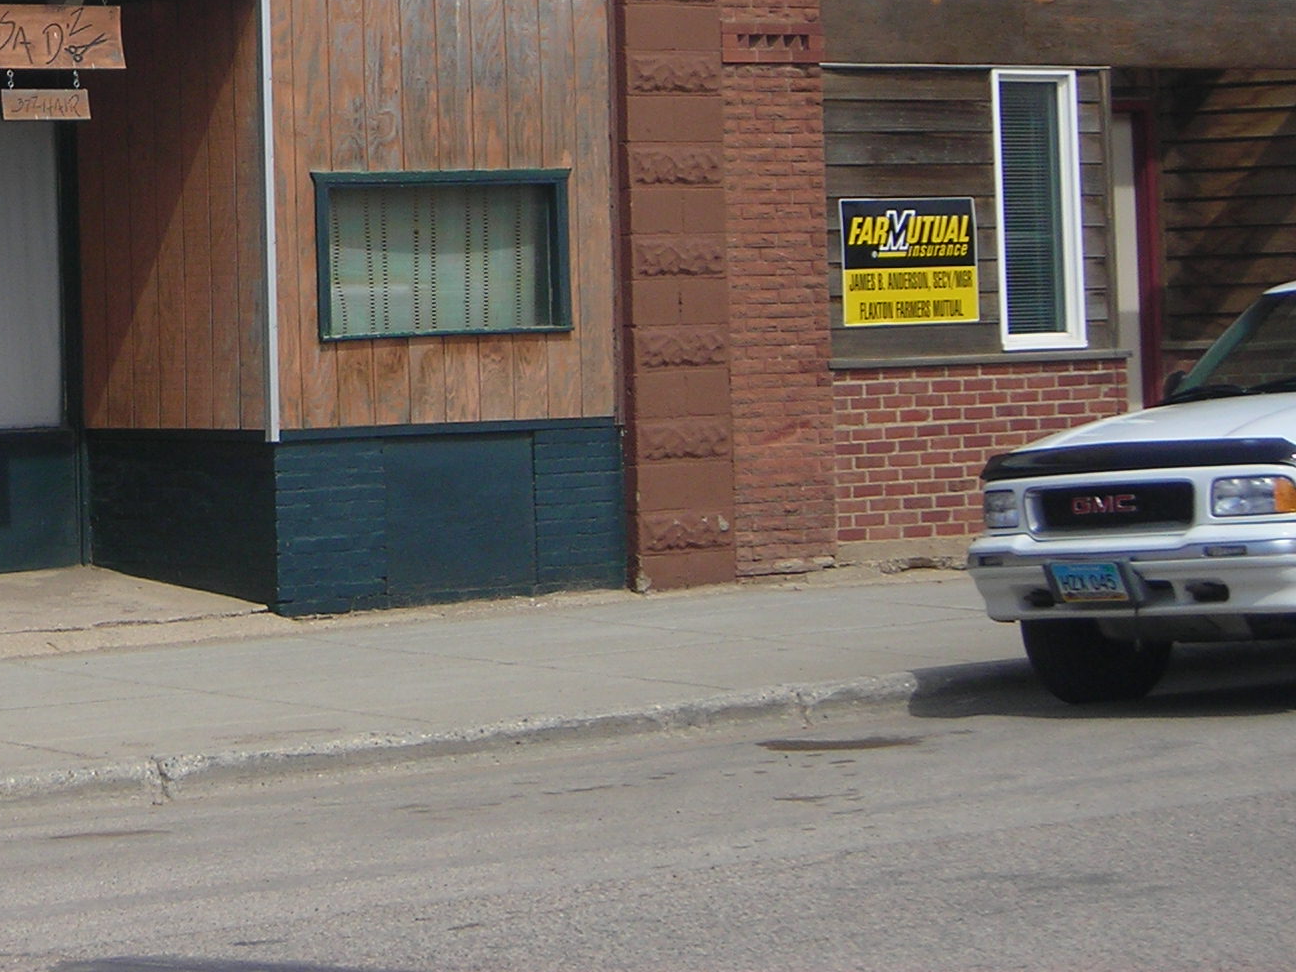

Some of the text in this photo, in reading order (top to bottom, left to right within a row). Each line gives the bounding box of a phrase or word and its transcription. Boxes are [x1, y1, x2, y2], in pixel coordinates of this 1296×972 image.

[849, 273, 875, 291] JAMES
[860, 299, 964, 320] FLAXTON FARMERS MUTUAL
[1071, 494, 1136, 515] GMC
